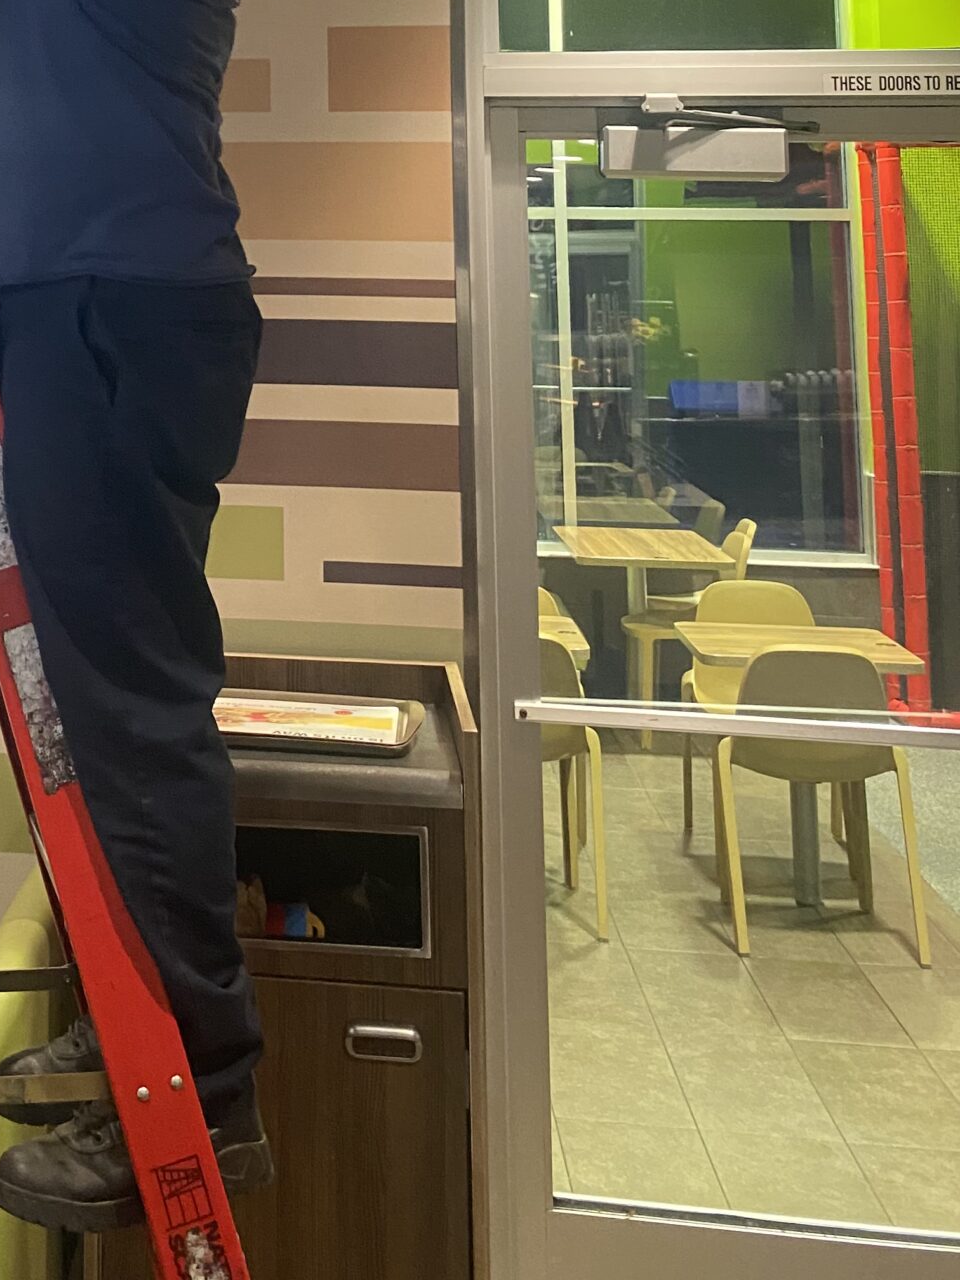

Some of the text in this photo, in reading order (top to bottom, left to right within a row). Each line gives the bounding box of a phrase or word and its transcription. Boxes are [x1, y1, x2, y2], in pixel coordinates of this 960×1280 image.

[831, 75, 873, 92] THESE
[879, 75, 921, 92] DOORS
[924, 75, 941, 91] TO
